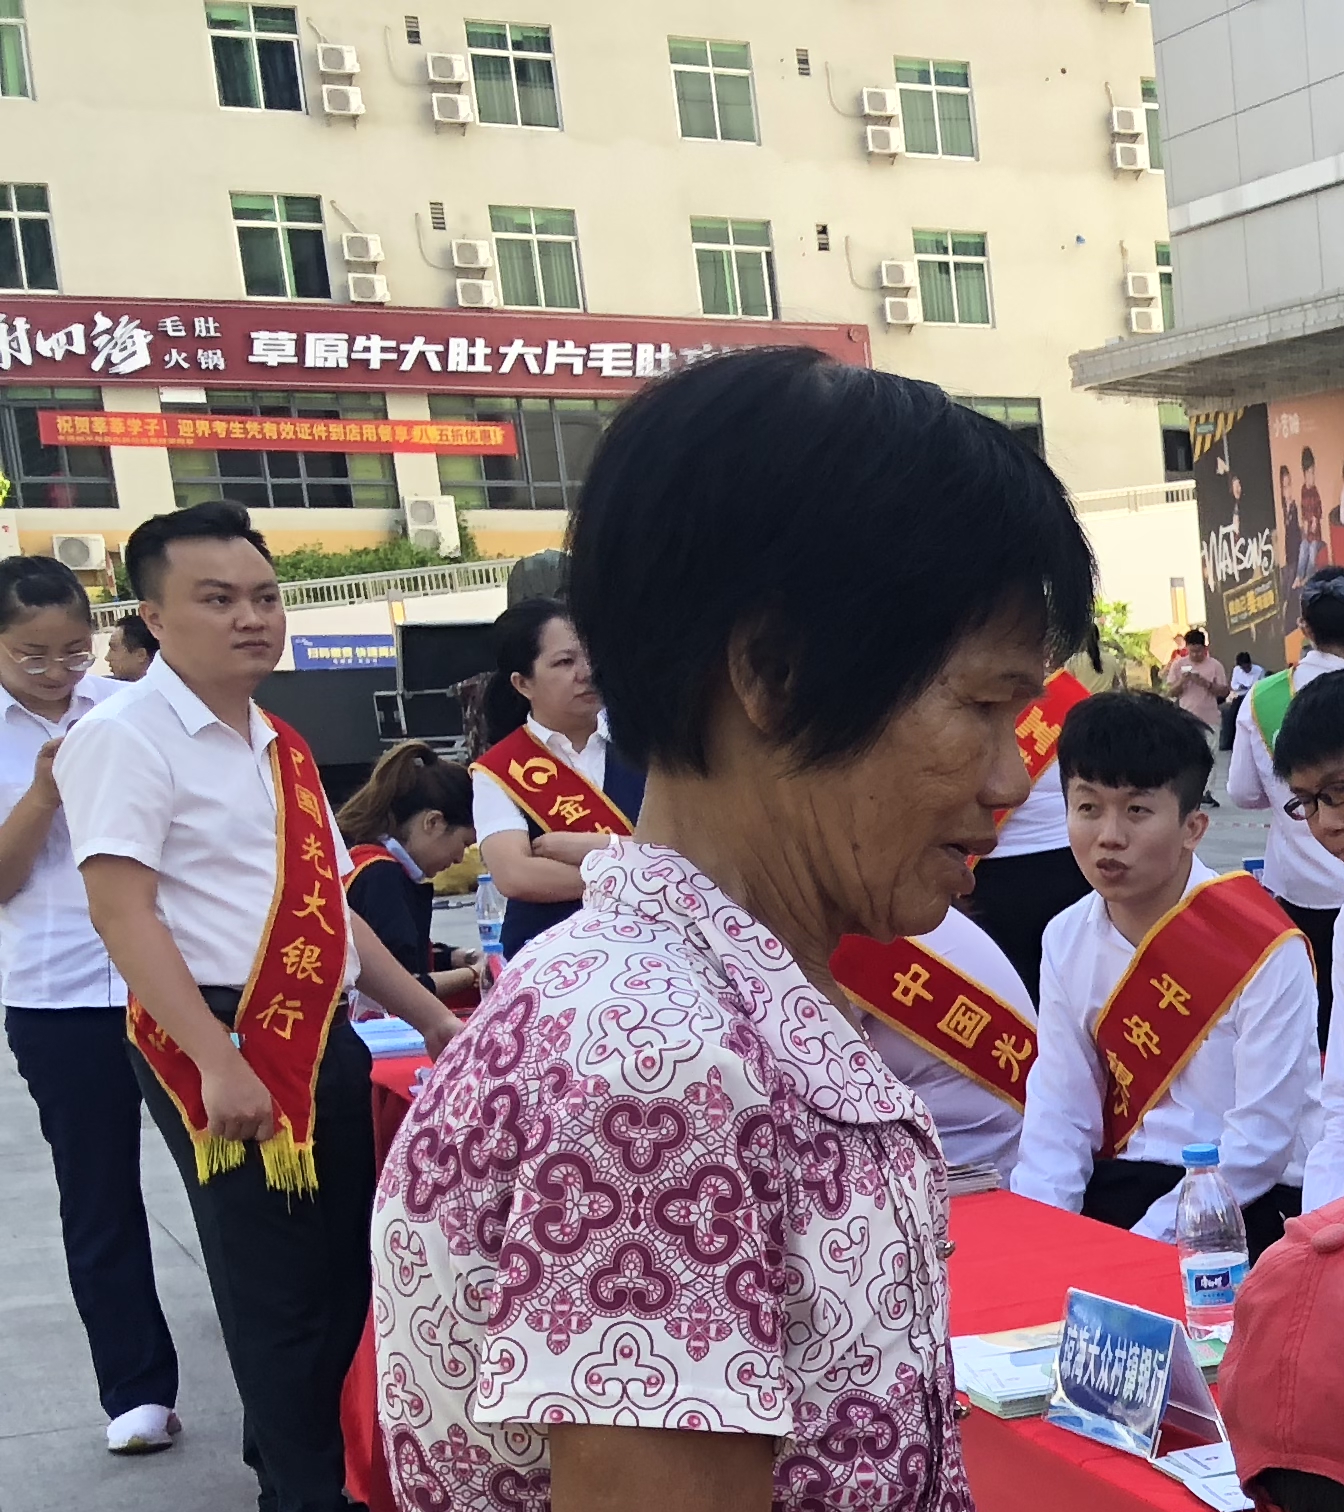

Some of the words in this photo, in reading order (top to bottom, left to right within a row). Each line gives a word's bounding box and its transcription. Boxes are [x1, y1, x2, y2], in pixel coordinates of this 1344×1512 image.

[159, 316, 222, 338] 毛肚
[163, 348, 226, 372] 火锅
[248, 330, 718, 379] 草原牛大肚大片毛肚
[892, 963, 1035, 1083] 中国光
